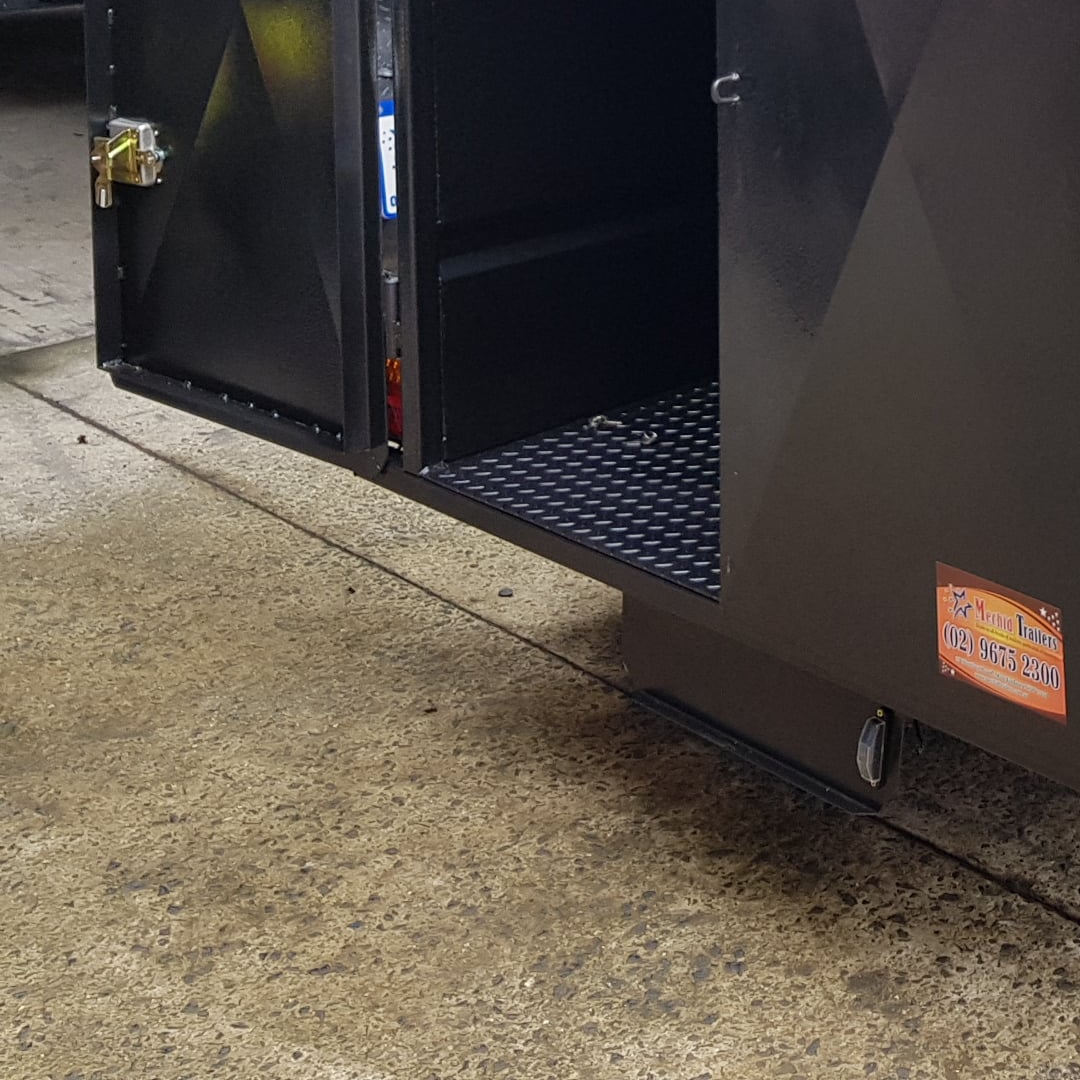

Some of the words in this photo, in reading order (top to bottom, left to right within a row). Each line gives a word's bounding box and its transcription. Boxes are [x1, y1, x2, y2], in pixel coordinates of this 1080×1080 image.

[975, 598, 1013, 633] Mechid
[1016, 613, 1058, 650] Trailers
[943, 621, 975, 656] (02)
[980, 637, 1017, 672] 9675
[1022, 654, 1060, 689] 2300
